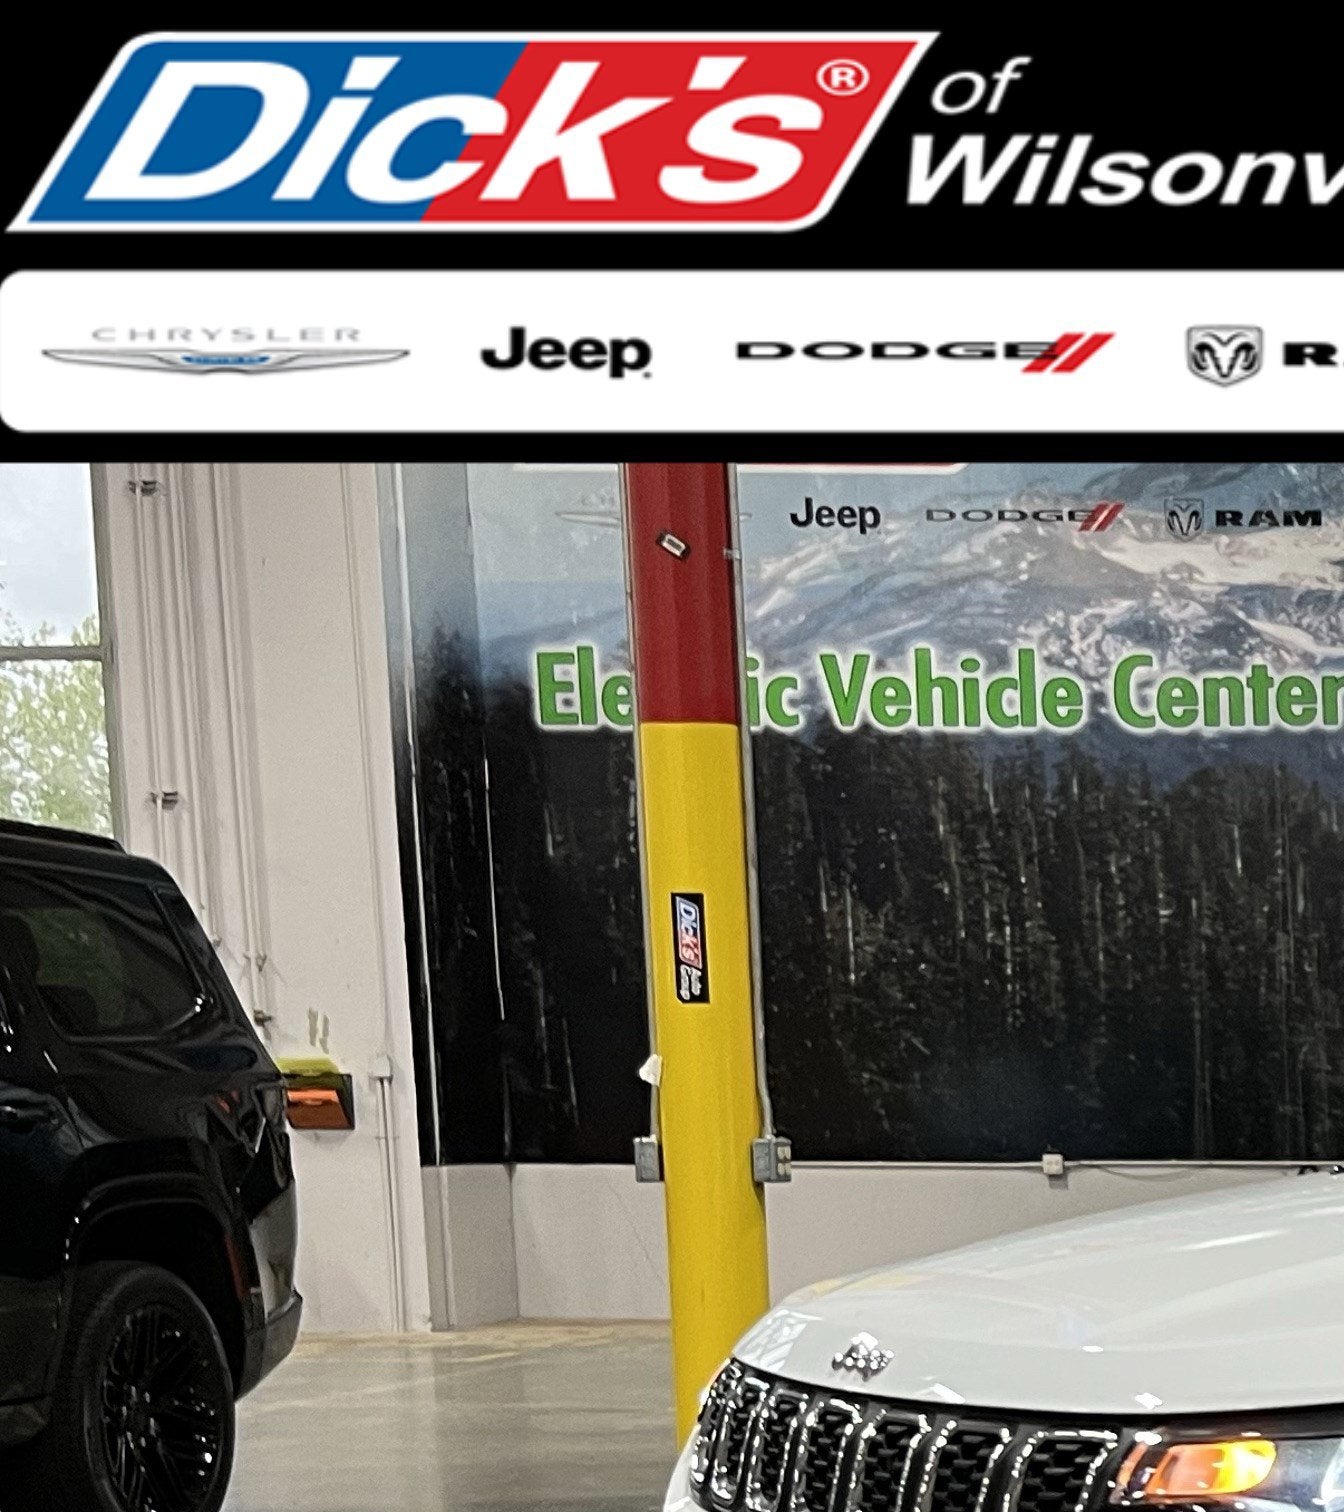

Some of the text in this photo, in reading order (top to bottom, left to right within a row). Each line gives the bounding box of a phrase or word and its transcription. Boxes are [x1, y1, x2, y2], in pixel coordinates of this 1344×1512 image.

[789, 496, 881, 535] Jeep
[925, 507, 1092, 523] DODGE
[1214, 508, 1323, 528] RAM
[536, 645, 800, 727] Eleic
[818, 647, 1085, 729] Vehicle
